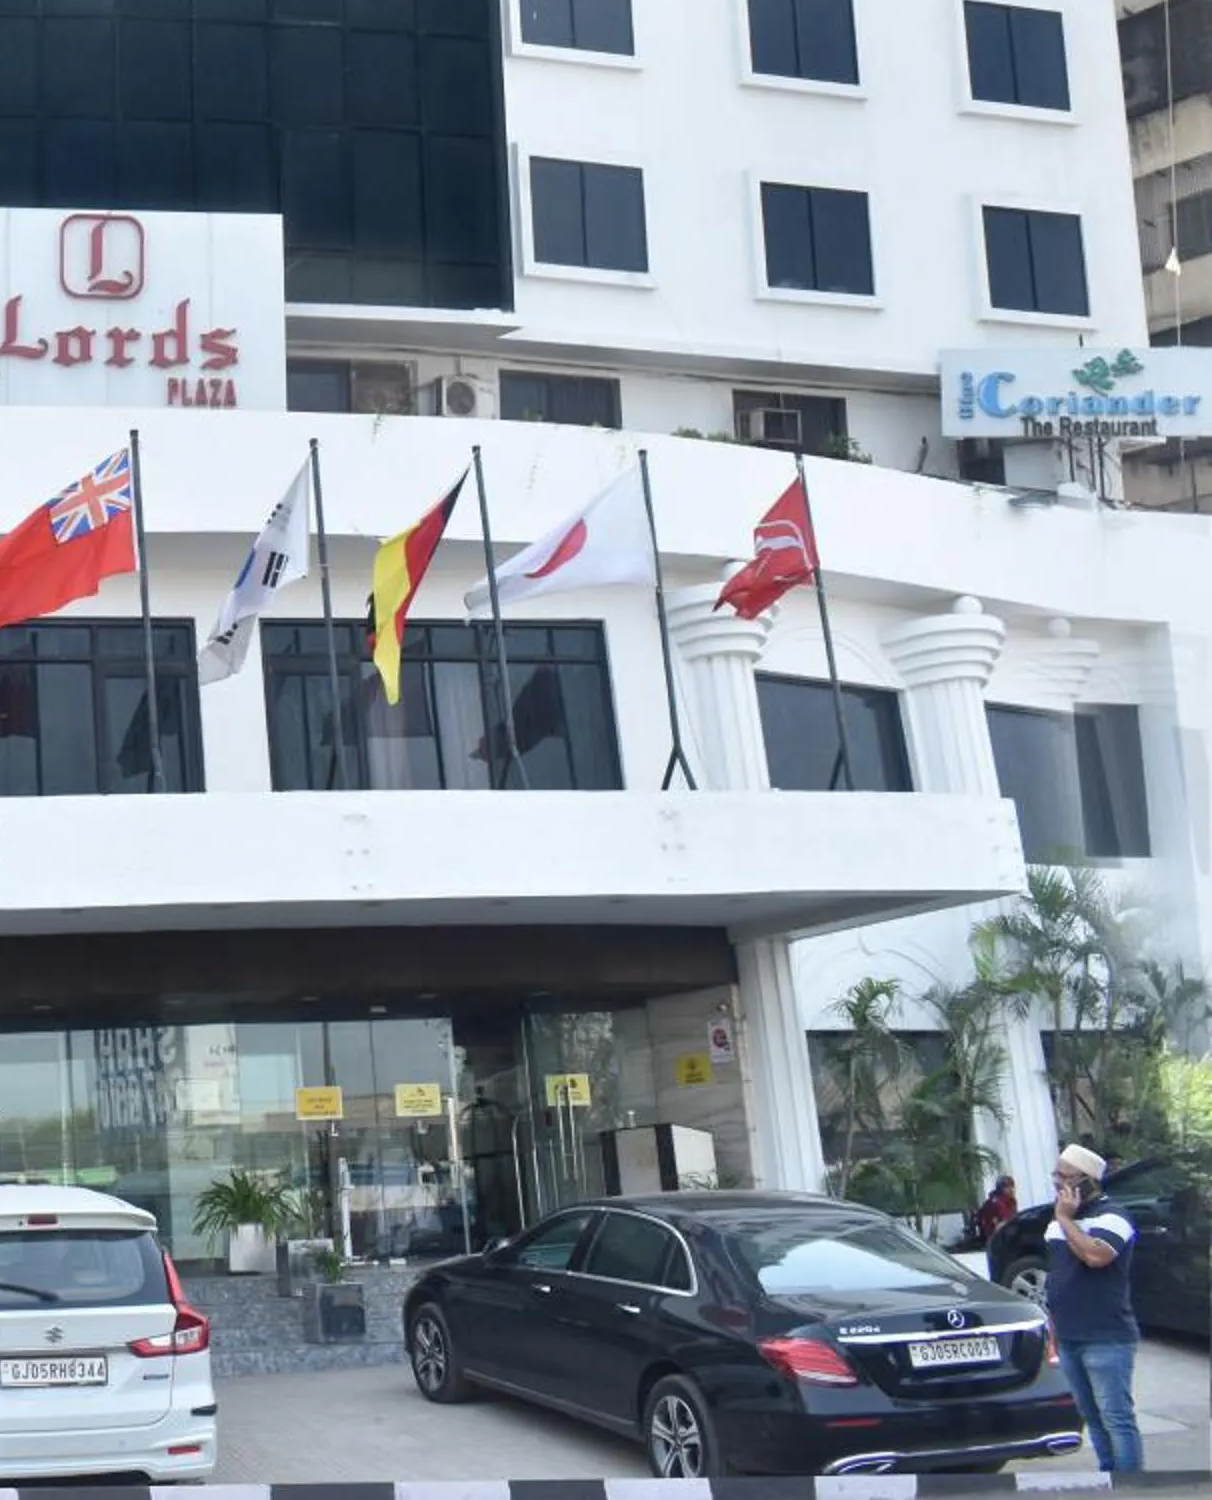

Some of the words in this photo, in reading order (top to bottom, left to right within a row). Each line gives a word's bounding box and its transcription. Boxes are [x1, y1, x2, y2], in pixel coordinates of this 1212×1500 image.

[167, 377, 237, 408] PLAZA
[976, 371, 1203, 419] Coriander
[1020, 416, 1054, 438] The
[1059, 415, 1158, 438] Restaurant
